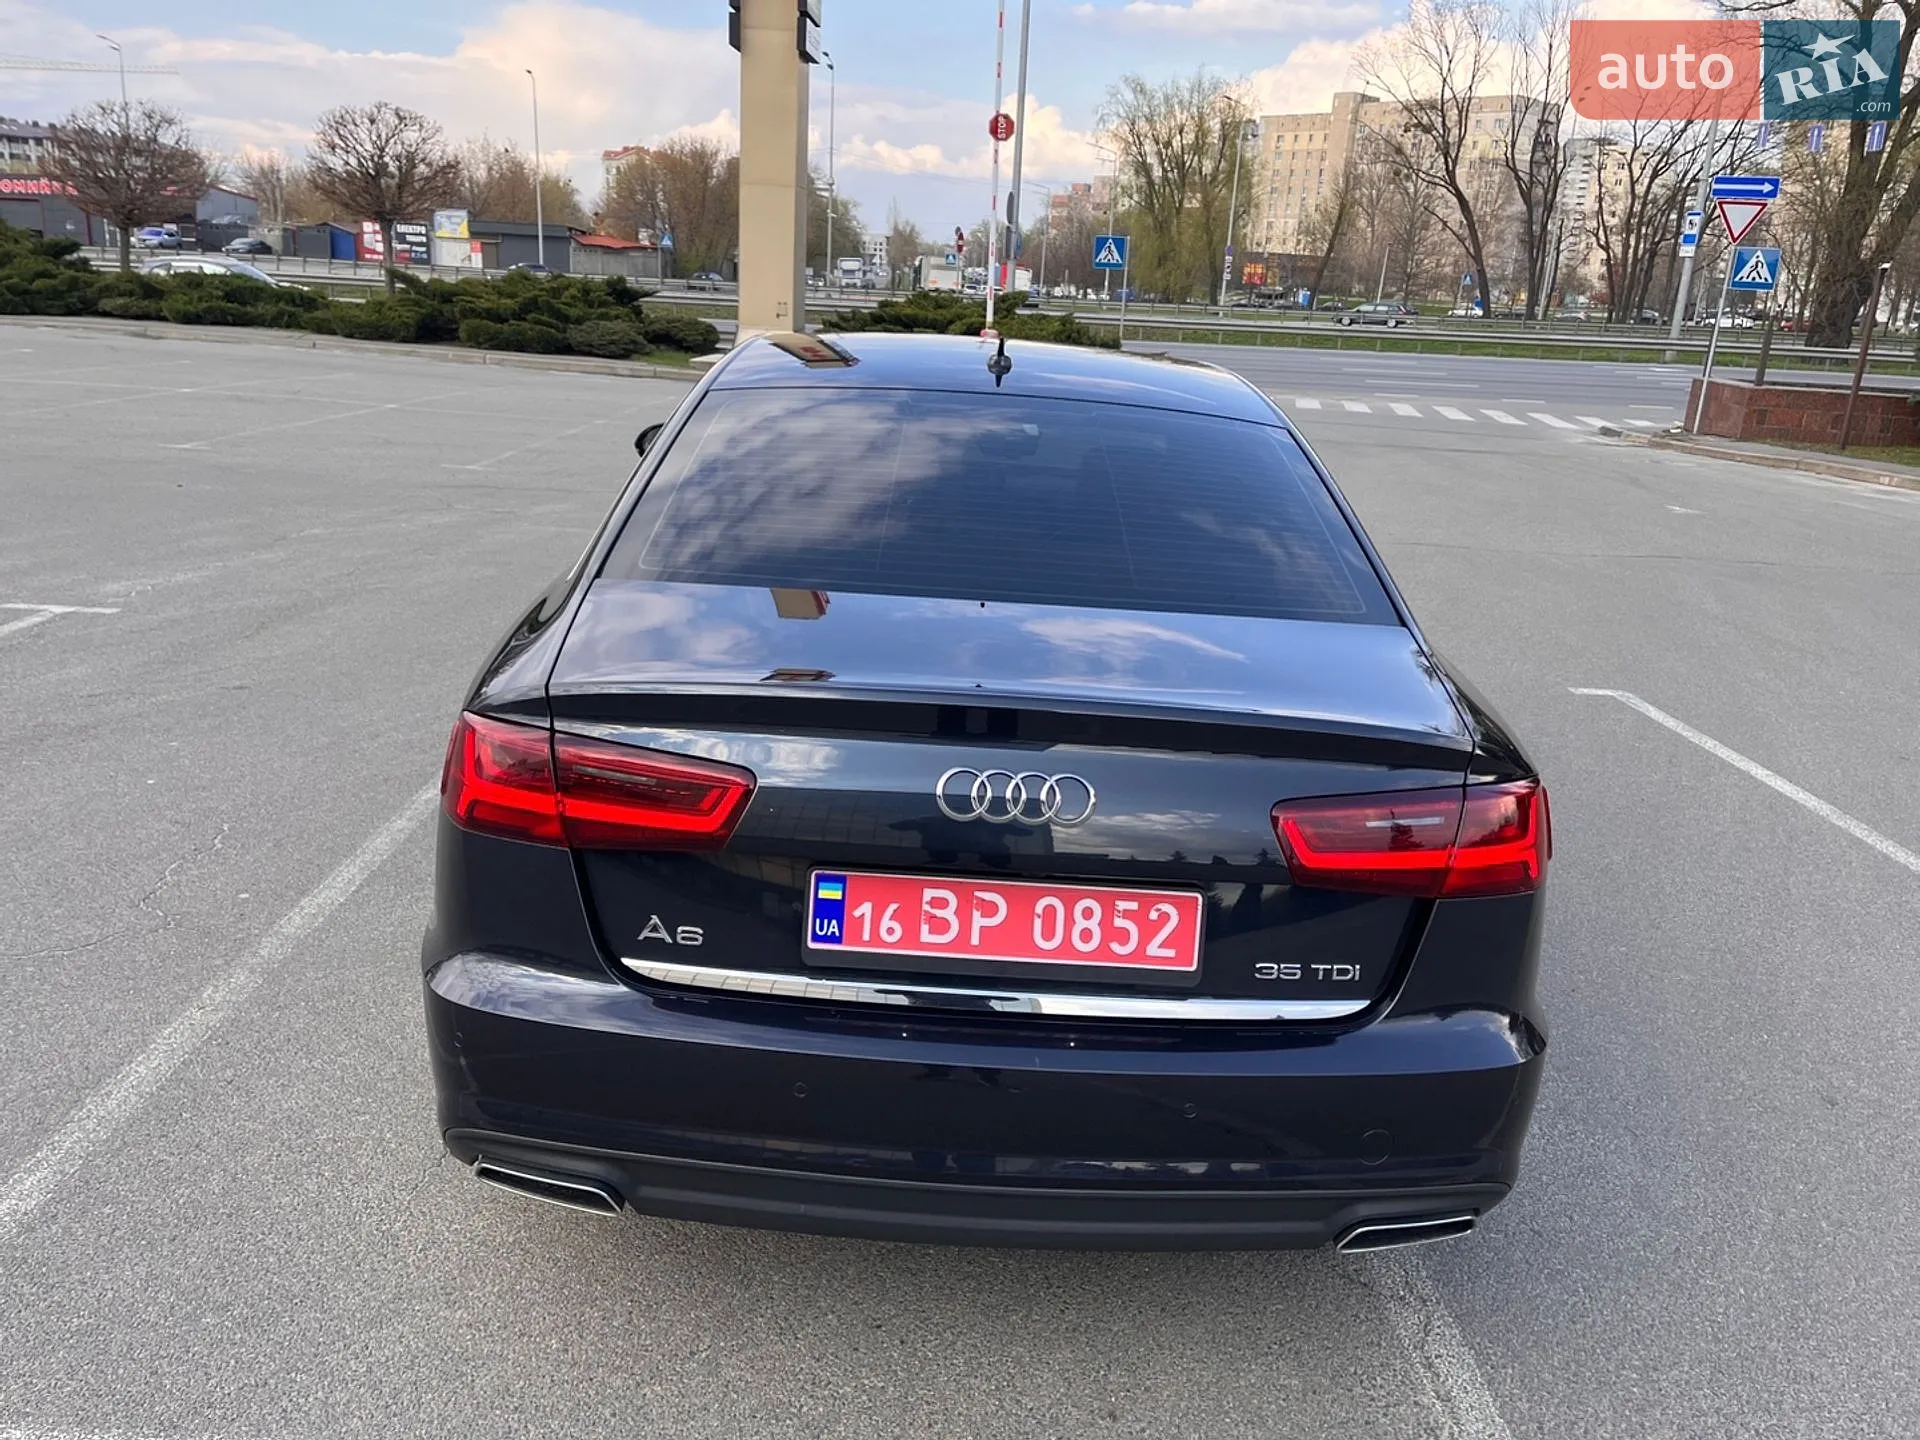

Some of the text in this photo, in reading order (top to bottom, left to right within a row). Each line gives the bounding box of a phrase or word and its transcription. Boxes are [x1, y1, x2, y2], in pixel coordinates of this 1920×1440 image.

[997, 115, 1007, 139] STOP
[637, 914, 704, 946] A6
[815, 918, 840, 937] UA
[852, 887, 1180, 958] 16 BP 0852
[1254, 963, 1360, 981] 35 TDI
